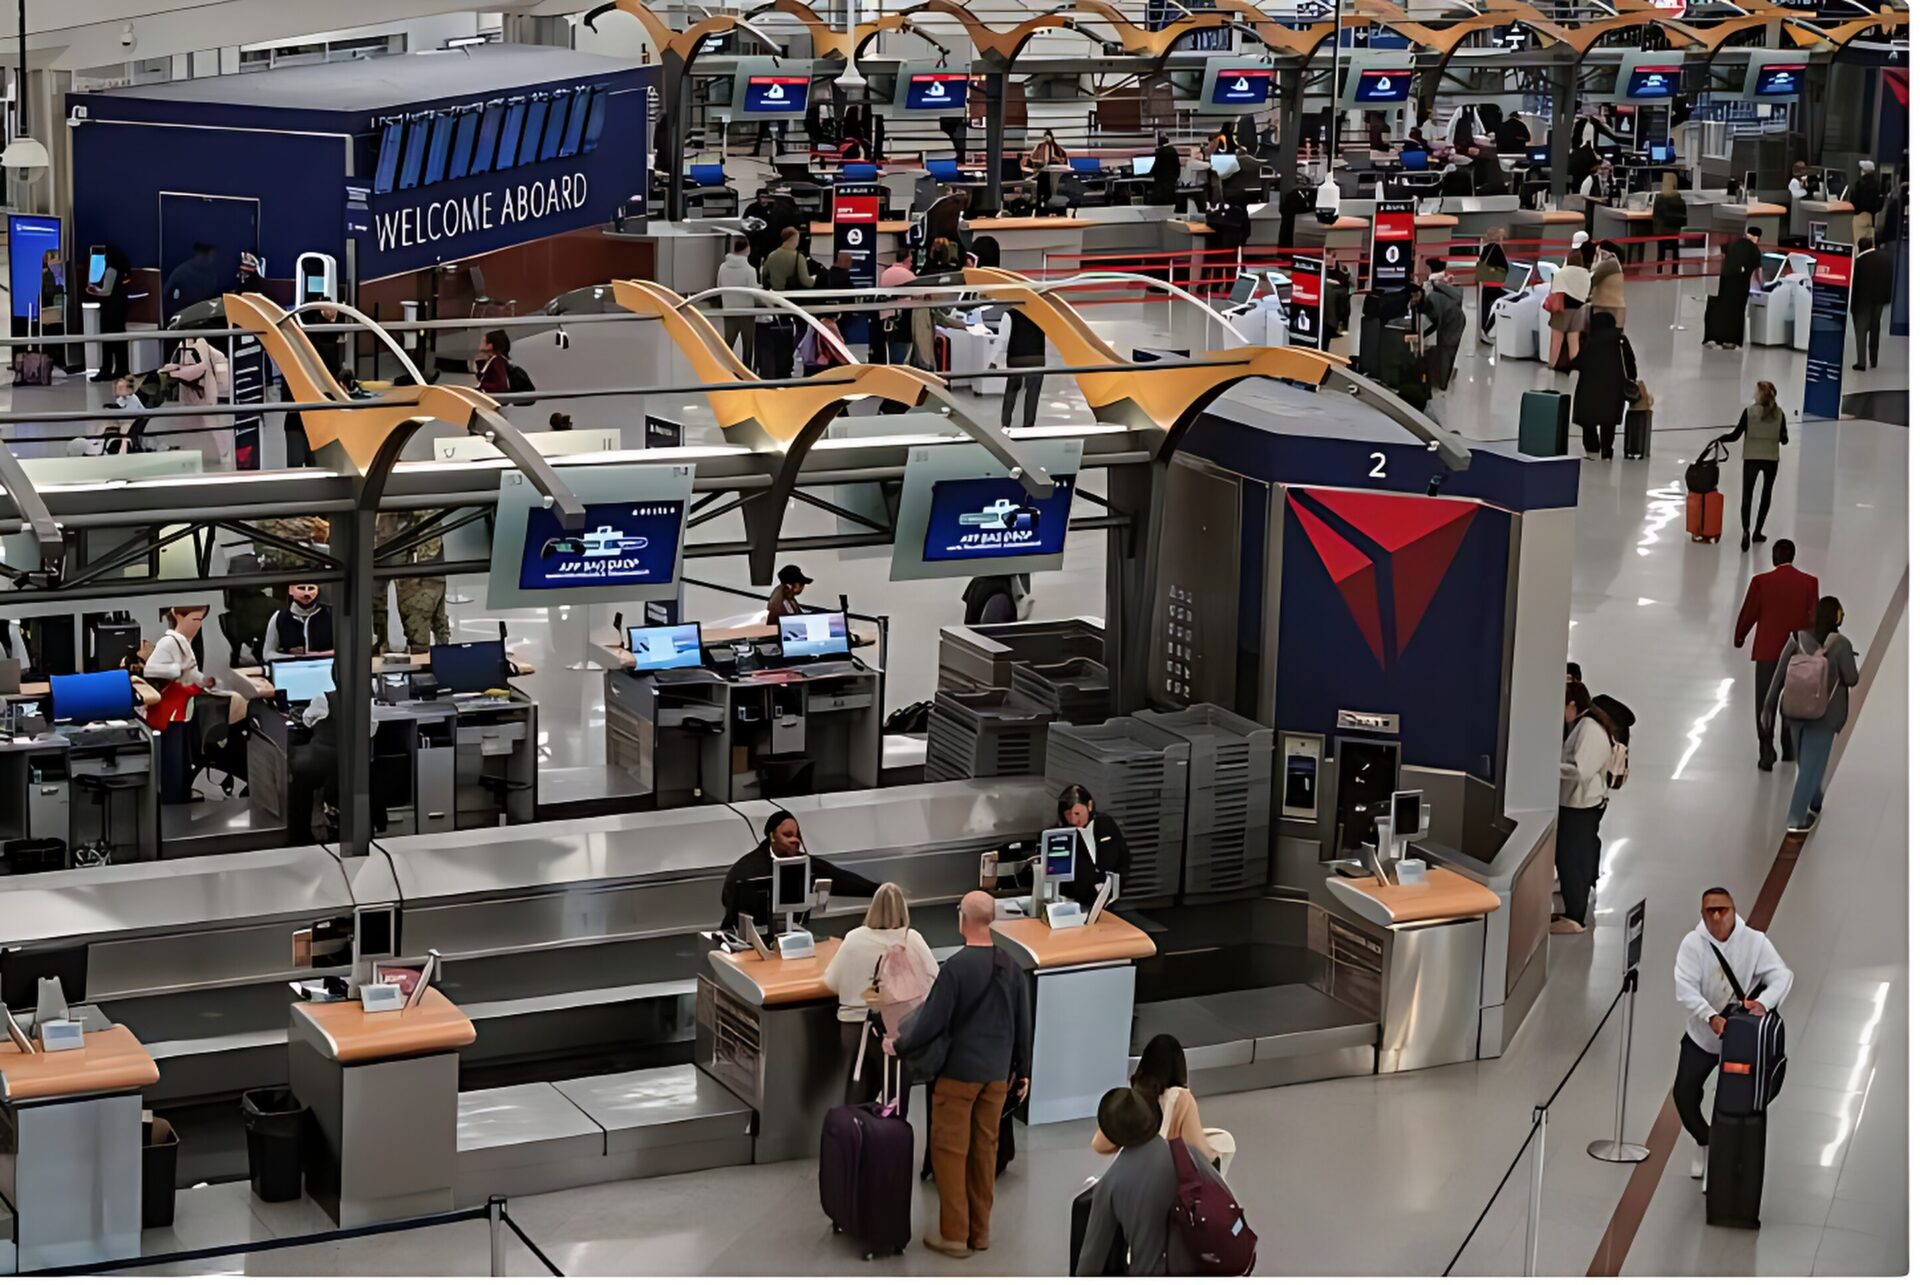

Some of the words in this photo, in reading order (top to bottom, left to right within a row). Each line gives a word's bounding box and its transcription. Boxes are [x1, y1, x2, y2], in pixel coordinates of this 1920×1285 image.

[375, 192, 493, 251] WELCOME
[501, 173, 587, 225] ABOARD
[1369, 452, 1386, 478] 2
